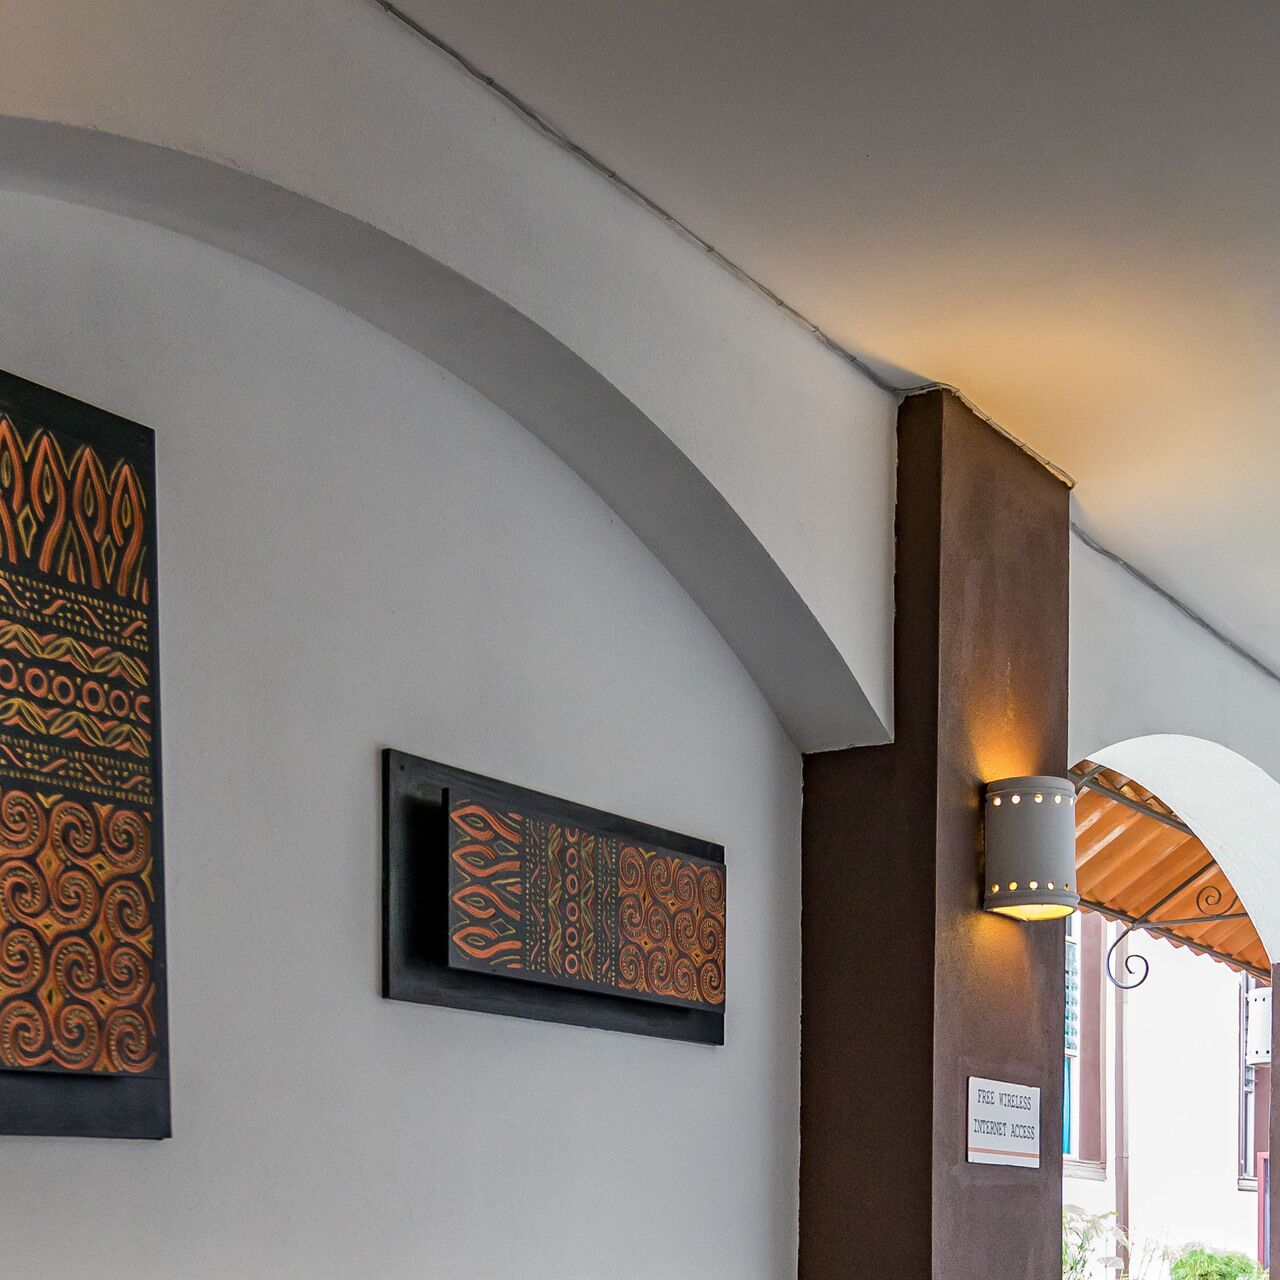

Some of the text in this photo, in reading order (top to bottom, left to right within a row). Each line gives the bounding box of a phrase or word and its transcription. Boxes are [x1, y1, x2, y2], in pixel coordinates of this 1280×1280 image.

[977, 1089, 1031, 1110] FREE WIRELESS
[973, 1119, 1035, 1140] INTERNET ACCESS
